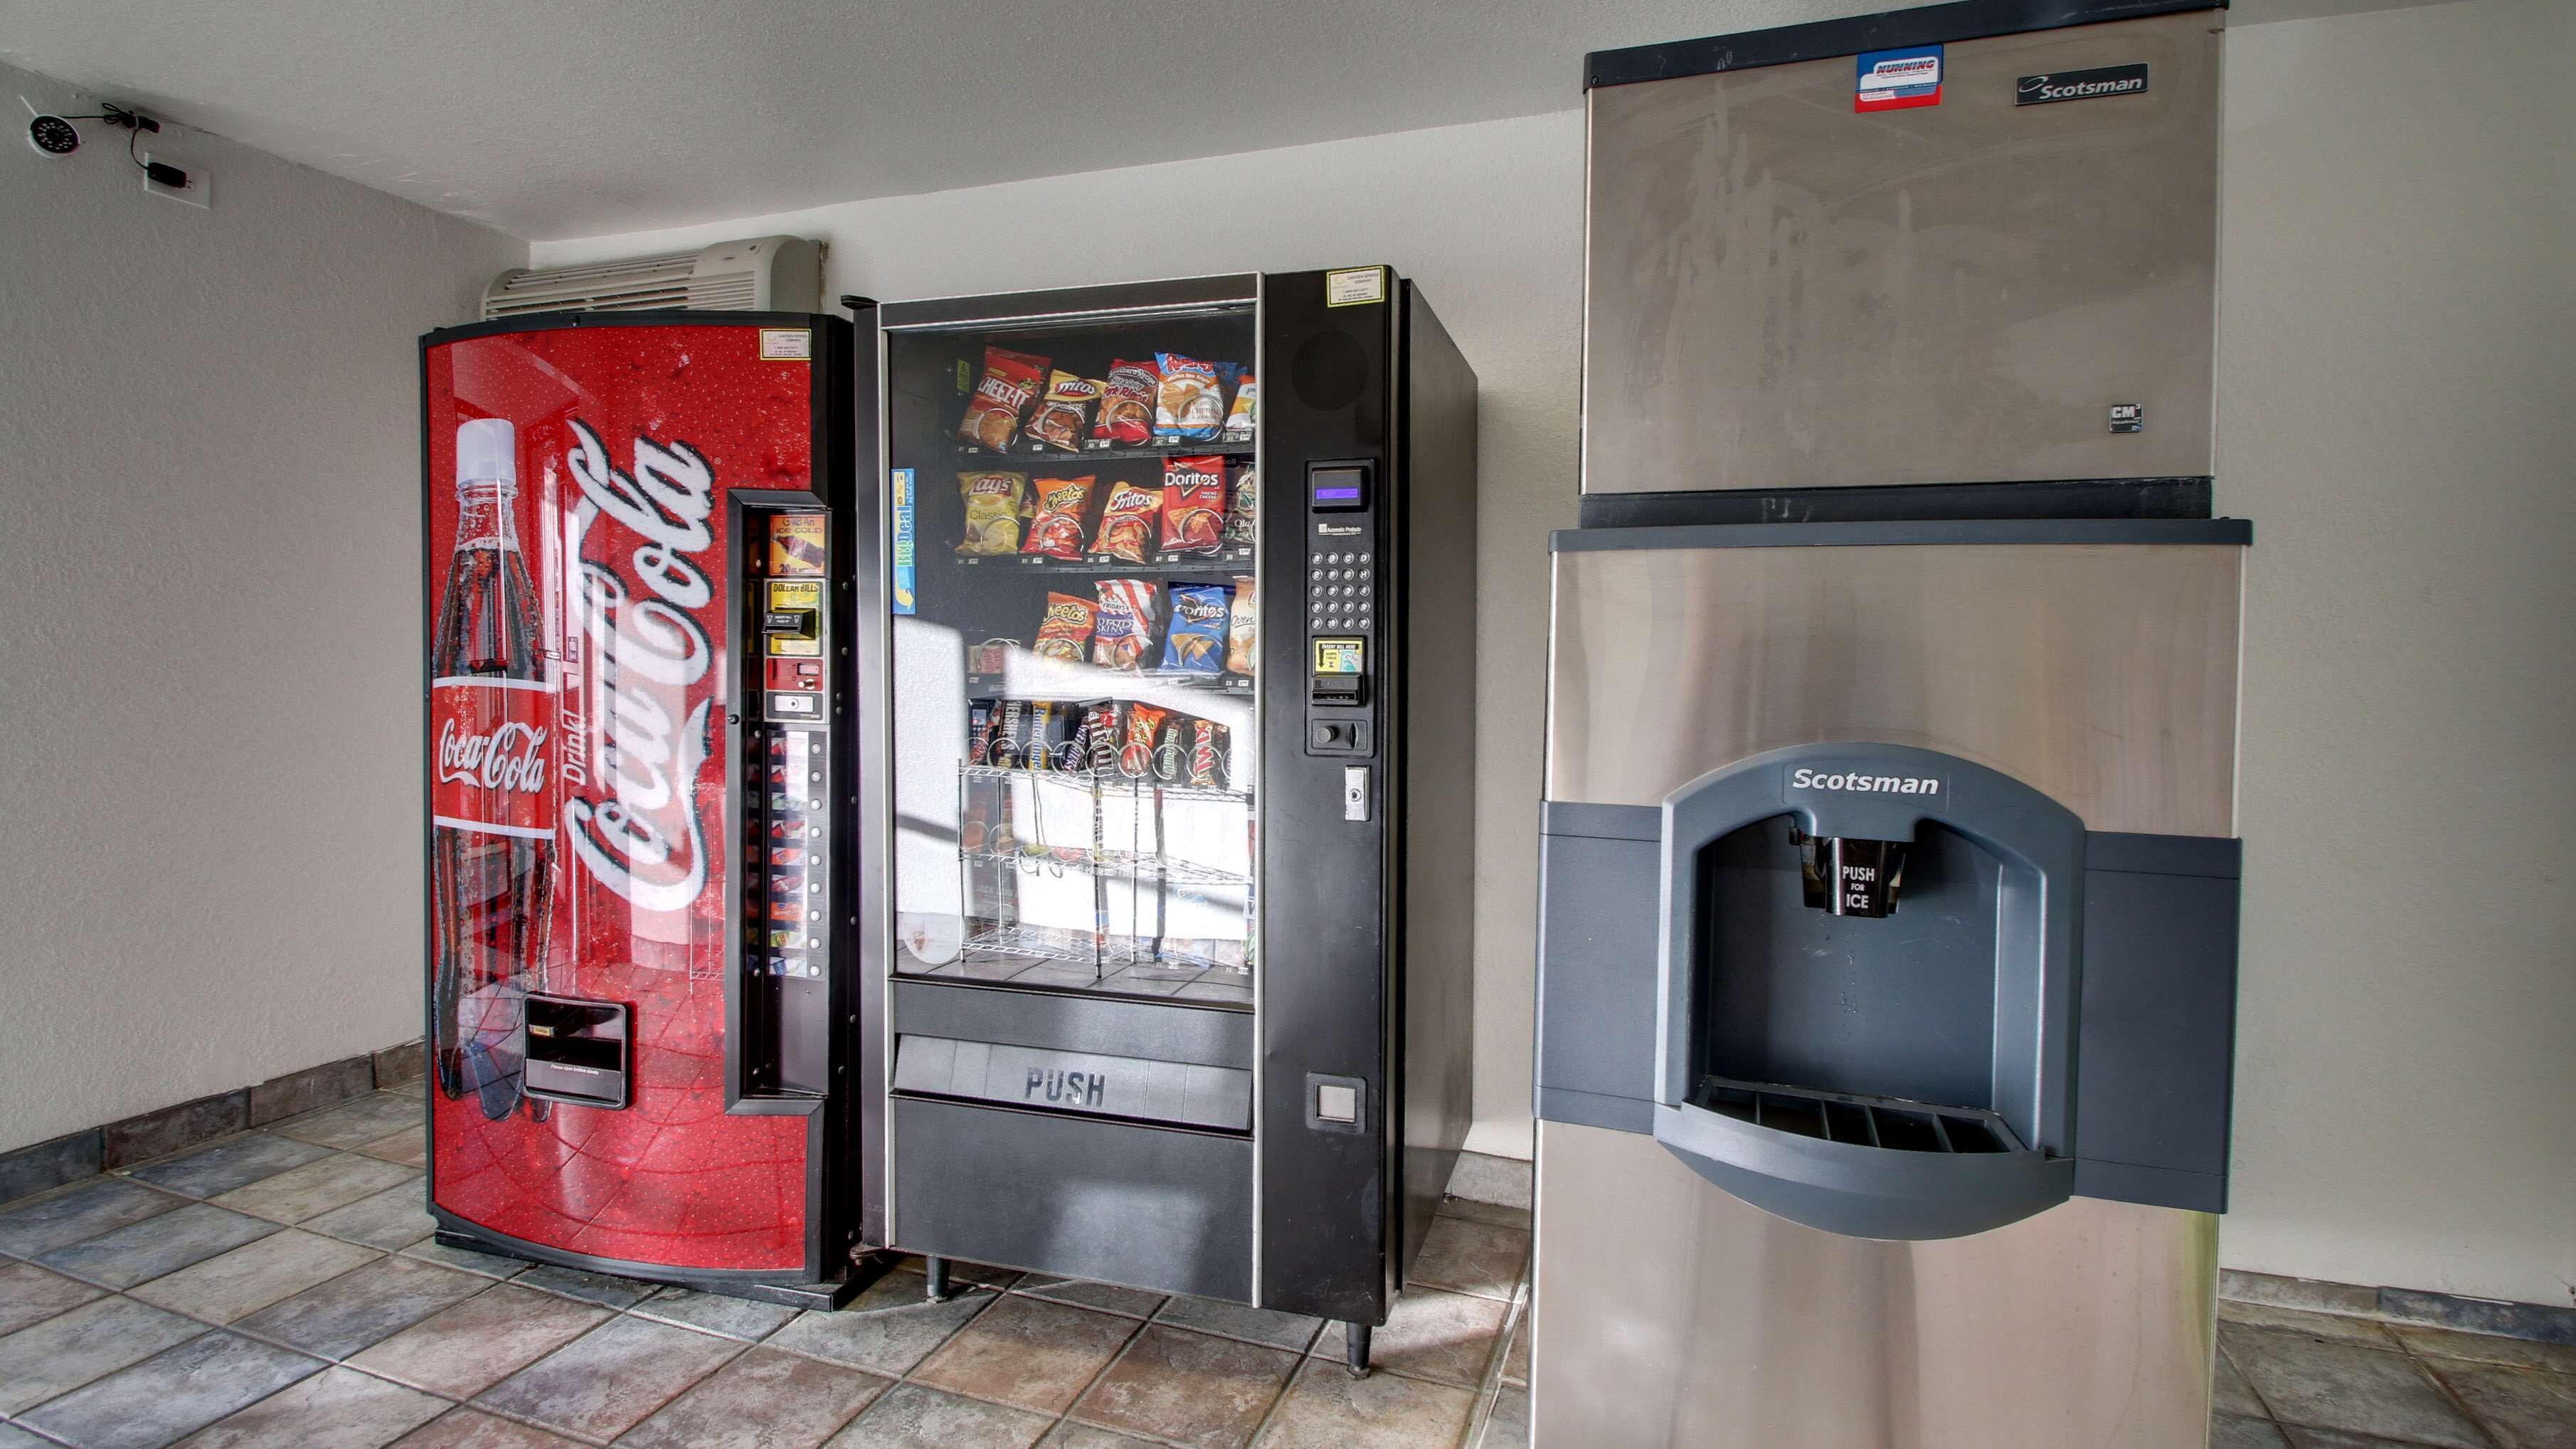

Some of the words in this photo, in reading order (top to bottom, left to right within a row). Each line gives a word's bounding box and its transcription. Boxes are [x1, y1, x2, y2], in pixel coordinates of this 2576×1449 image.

[2039, 76, 2141, 100] Scotsman
[969, 477, 1011, 497] Lay's
[1165, 472, 1219, 487] Doritos
[1044, 484, 1087, 511] Cheetos
[1111, 489, 1153, 511] Fritos
[800, 583, 819, 593] BILLS
[1043, 604, 1088, 624] heetos
[1231, 615, 1255, 626] Oven
[564, 418, 715, 912] Coca-Cola
[438, 718, 547, 793] Coca-Cola
[1162, 748, 1177, 775] Milky
[1194, 726, 1214, 775] TWIX
[1792, 768, 1939, 795] Scotsman
[1843, 866, 1875, 881] PUSH
[1850, 883, 1865, 891] FOR
[1846, 893, 1868, 908] ICE
[1024, 1067, 1105, 1107] PUSH
